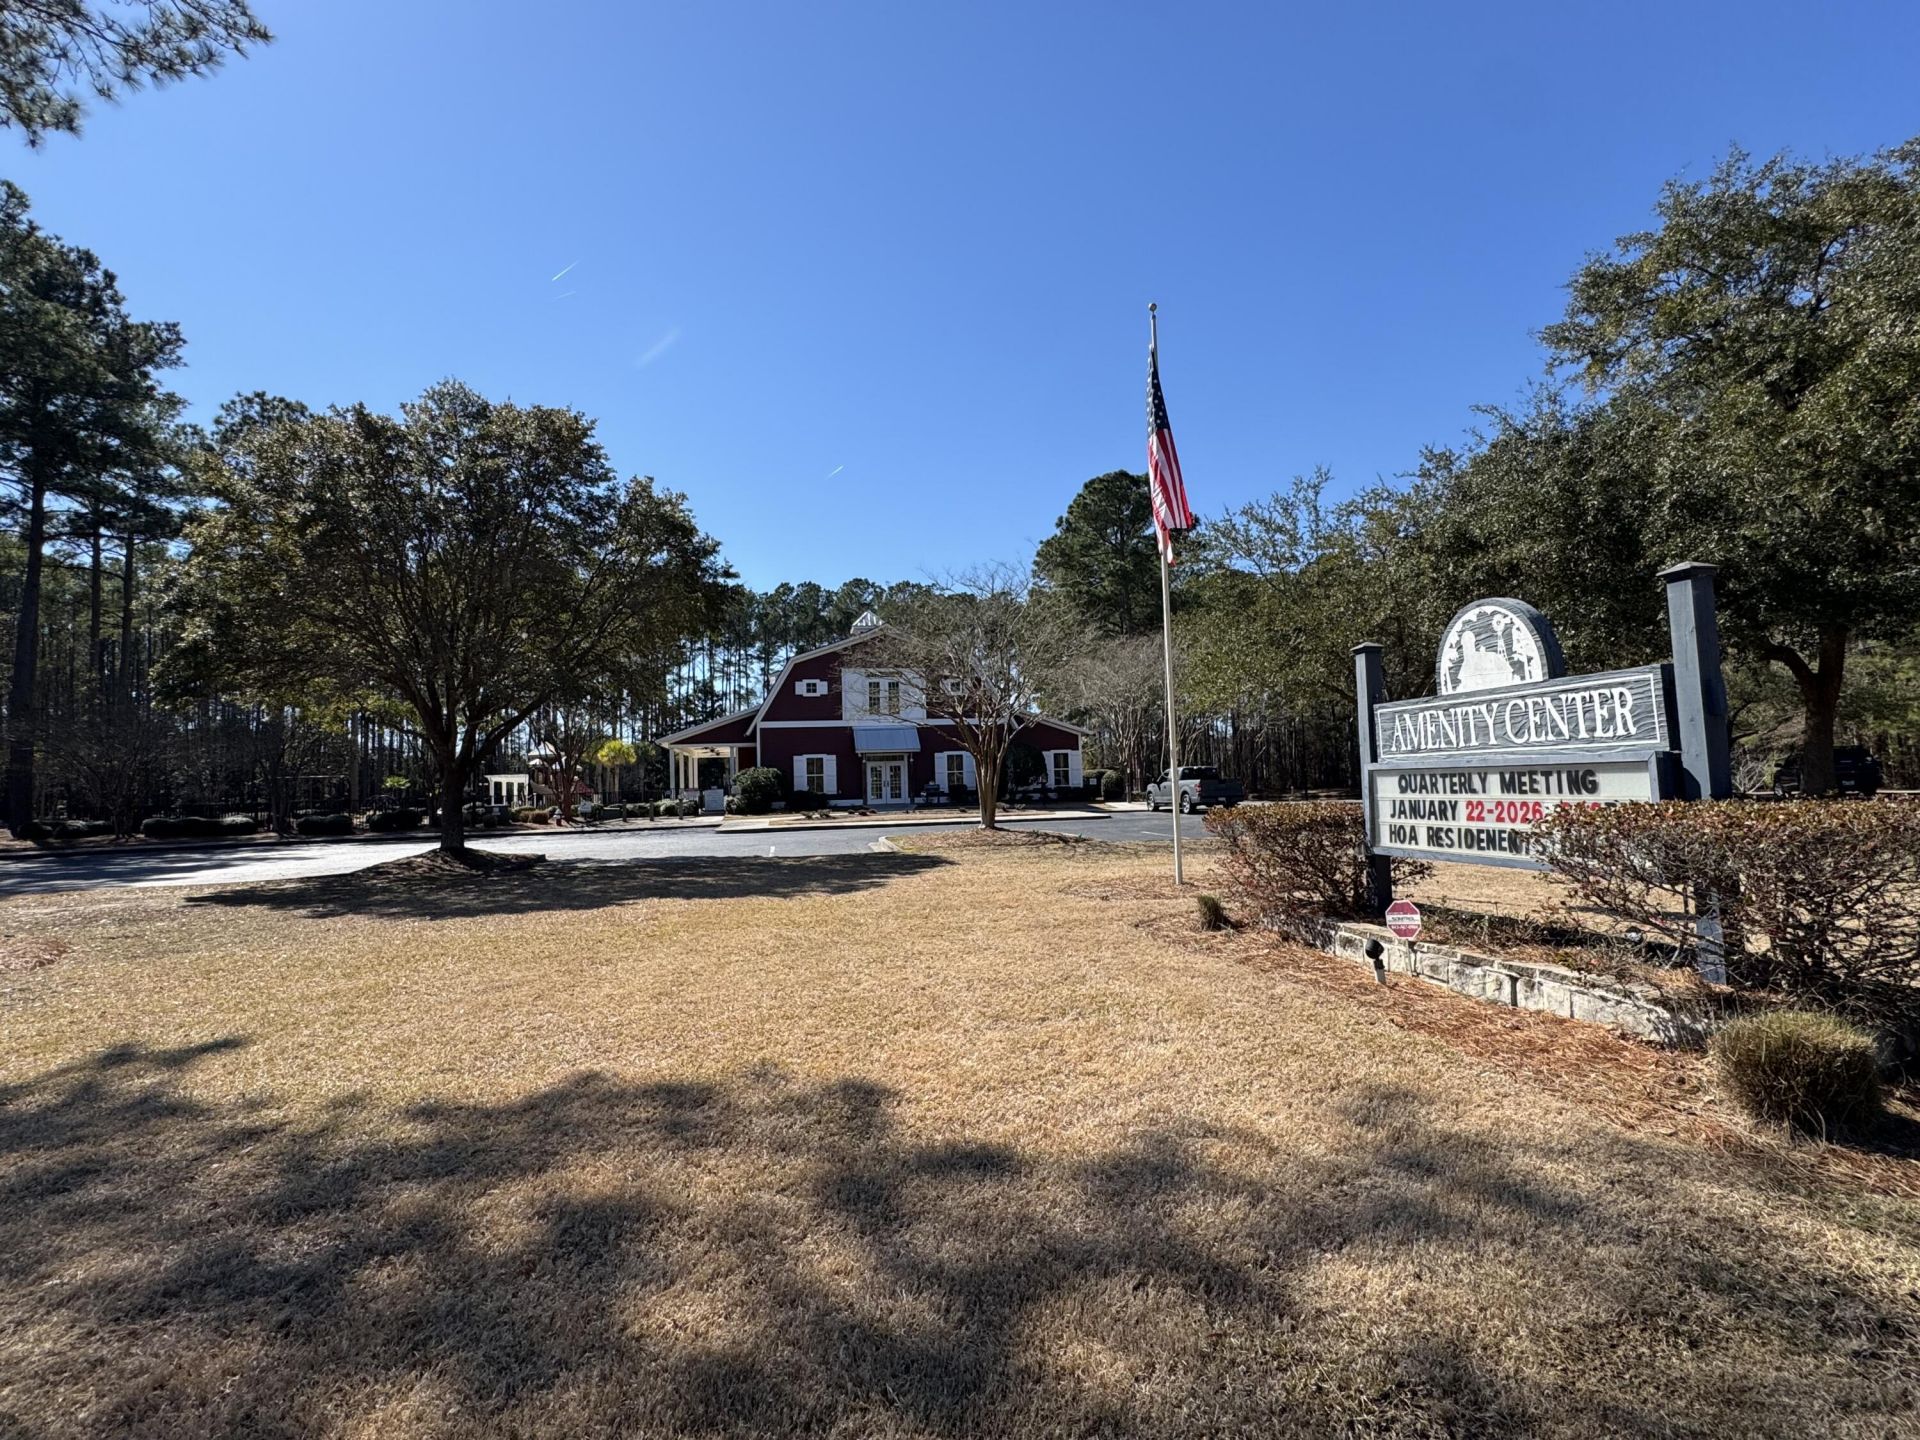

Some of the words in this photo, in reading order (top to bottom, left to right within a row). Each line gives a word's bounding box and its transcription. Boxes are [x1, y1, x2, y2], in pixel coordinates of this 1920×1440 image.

[1391, 703, 1499, 751] AMENITY
[1505, 687, 1637, 744] CENTER
[1398, 772, 1488, 794] QUARTERLY
[1499, 769, 1599, 795] MEETING
[1390, 799, 1459, 821] JANUARY
[1466, 800, 1543, 824] 22-2026
[1389, 824, 1419, 846] HOA
